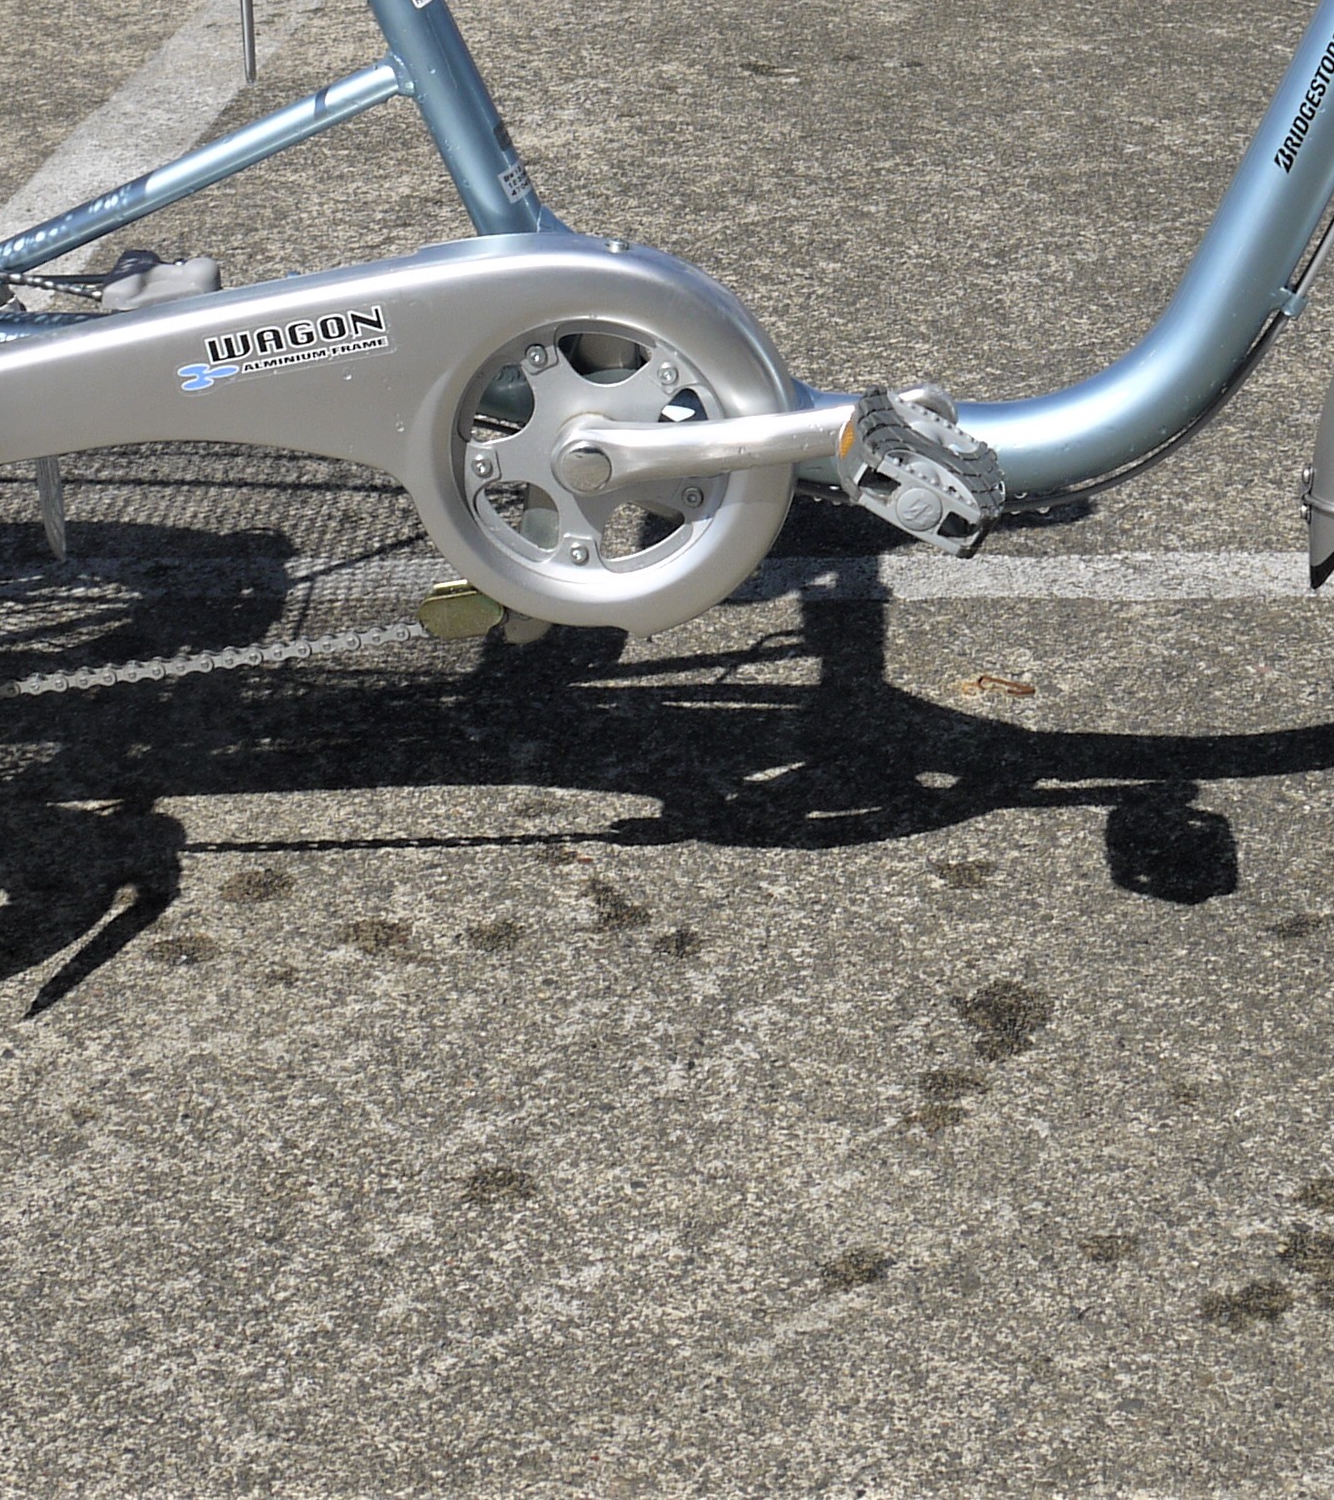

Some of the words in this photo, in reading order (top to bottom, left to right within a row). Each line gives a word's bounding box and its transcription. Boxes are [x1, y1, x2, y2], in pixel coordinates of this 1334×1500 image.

[205, 306, 387, 364] WAGON
[242, 349, 328, 373] ALMINIUM
[331, 336, 388, 356] FRAME
